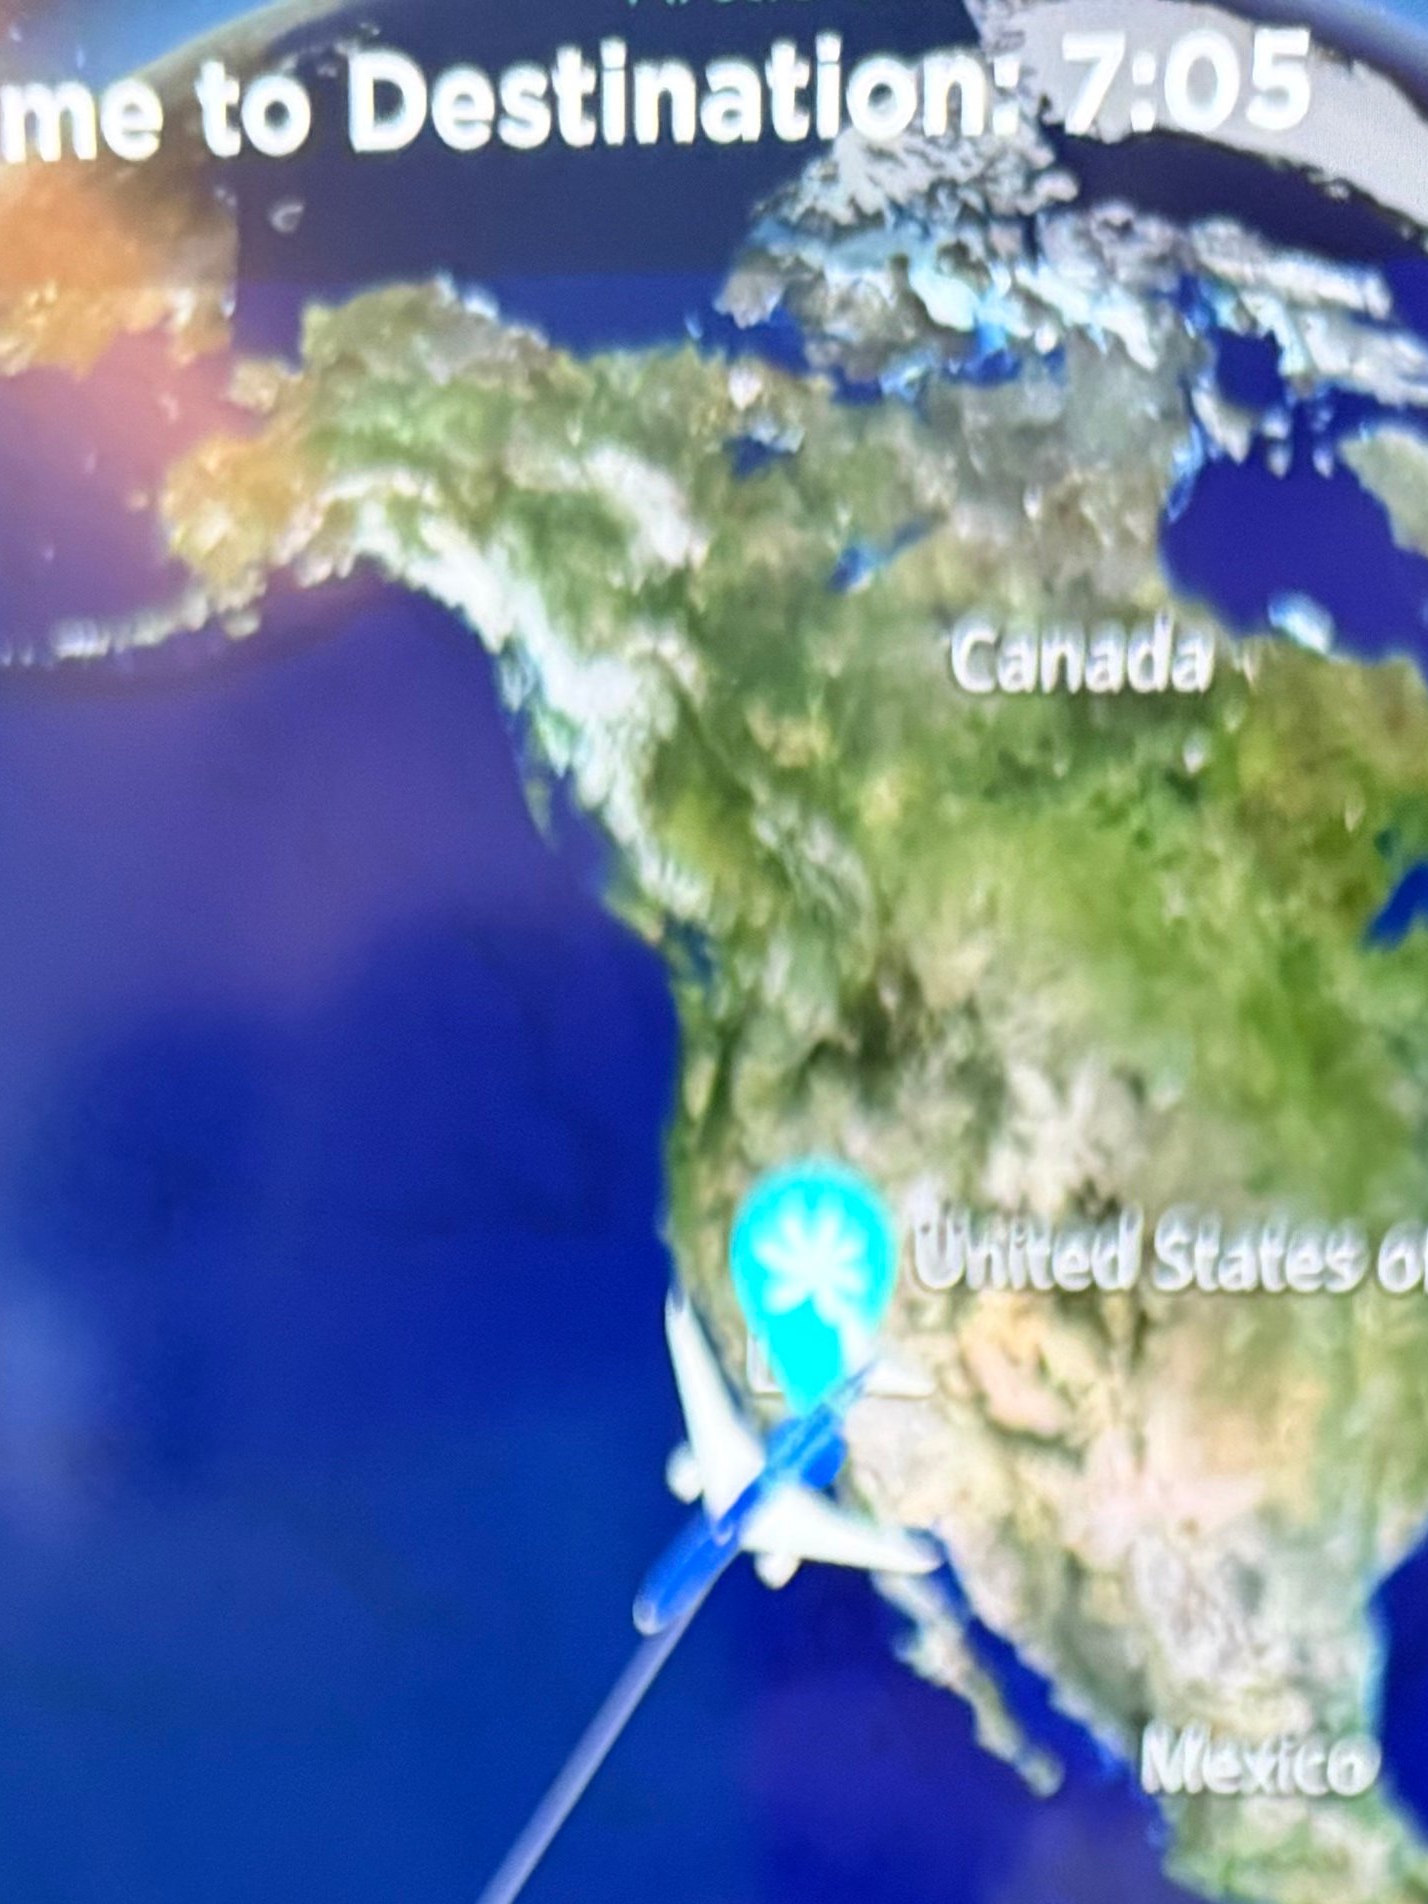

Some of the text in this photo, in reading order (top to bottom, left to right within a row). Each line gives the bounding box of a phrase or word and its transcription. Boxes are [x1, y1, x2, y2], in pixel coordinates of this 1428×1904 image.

[194, 60, 312, 158] to
[348, 29, 1021, 153] Destination:
[1061, 26, 1312, 136] 7:05
[950, 612, 1216, 695] Canada
[912, 1206, 1143, 1292] United
[1153, 1208, 1370, 1293] States
[1140, 1718, 1383, 1797] Mexico
